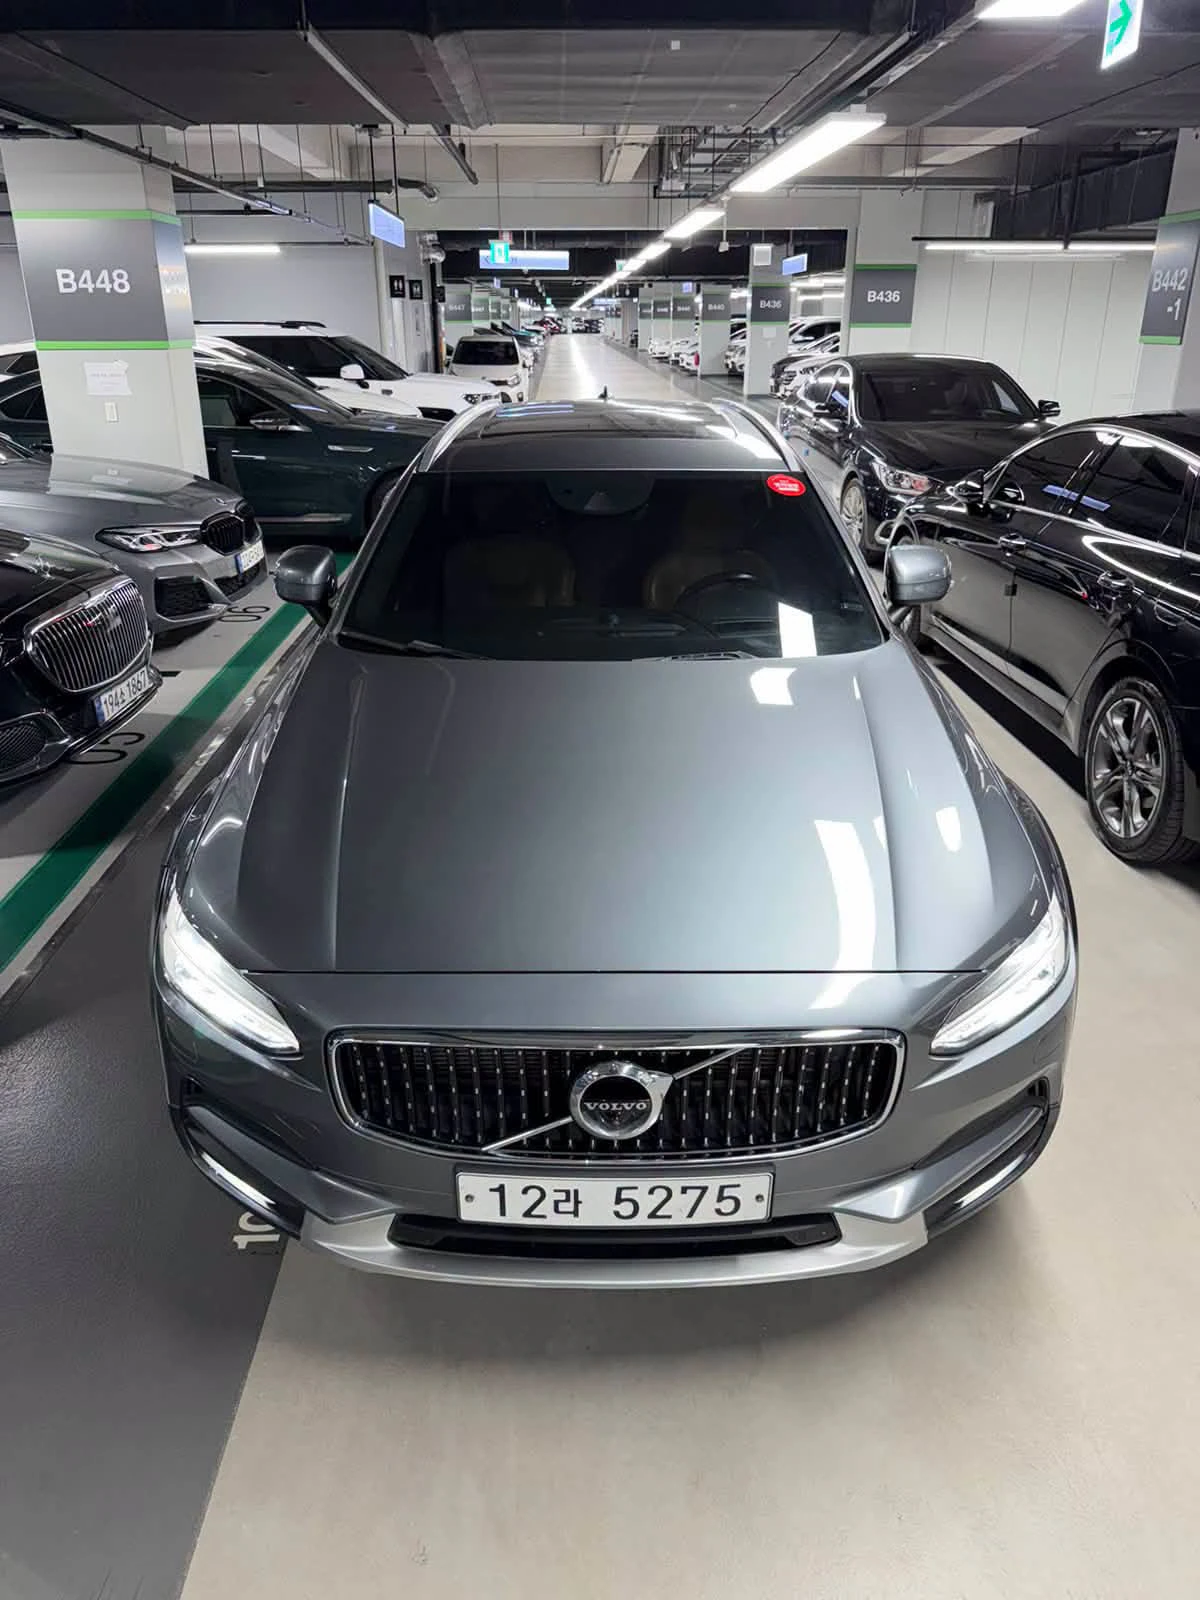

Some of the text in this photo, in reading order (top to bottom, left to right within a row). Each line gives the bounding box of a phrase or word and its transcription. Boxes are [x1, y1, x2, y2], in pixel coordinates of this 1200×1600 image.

[56, 268, 131, 293] B448
[1151, 267, 1188, 293] B442
[759, 300, 782, 309] B436
[867, 290, 901, 303] B436
[126, 669, 148, 698] 1867
[583, 1102, 648, 1111] VOLVO
[489, 1183, 742, 1220] 12라 5275
